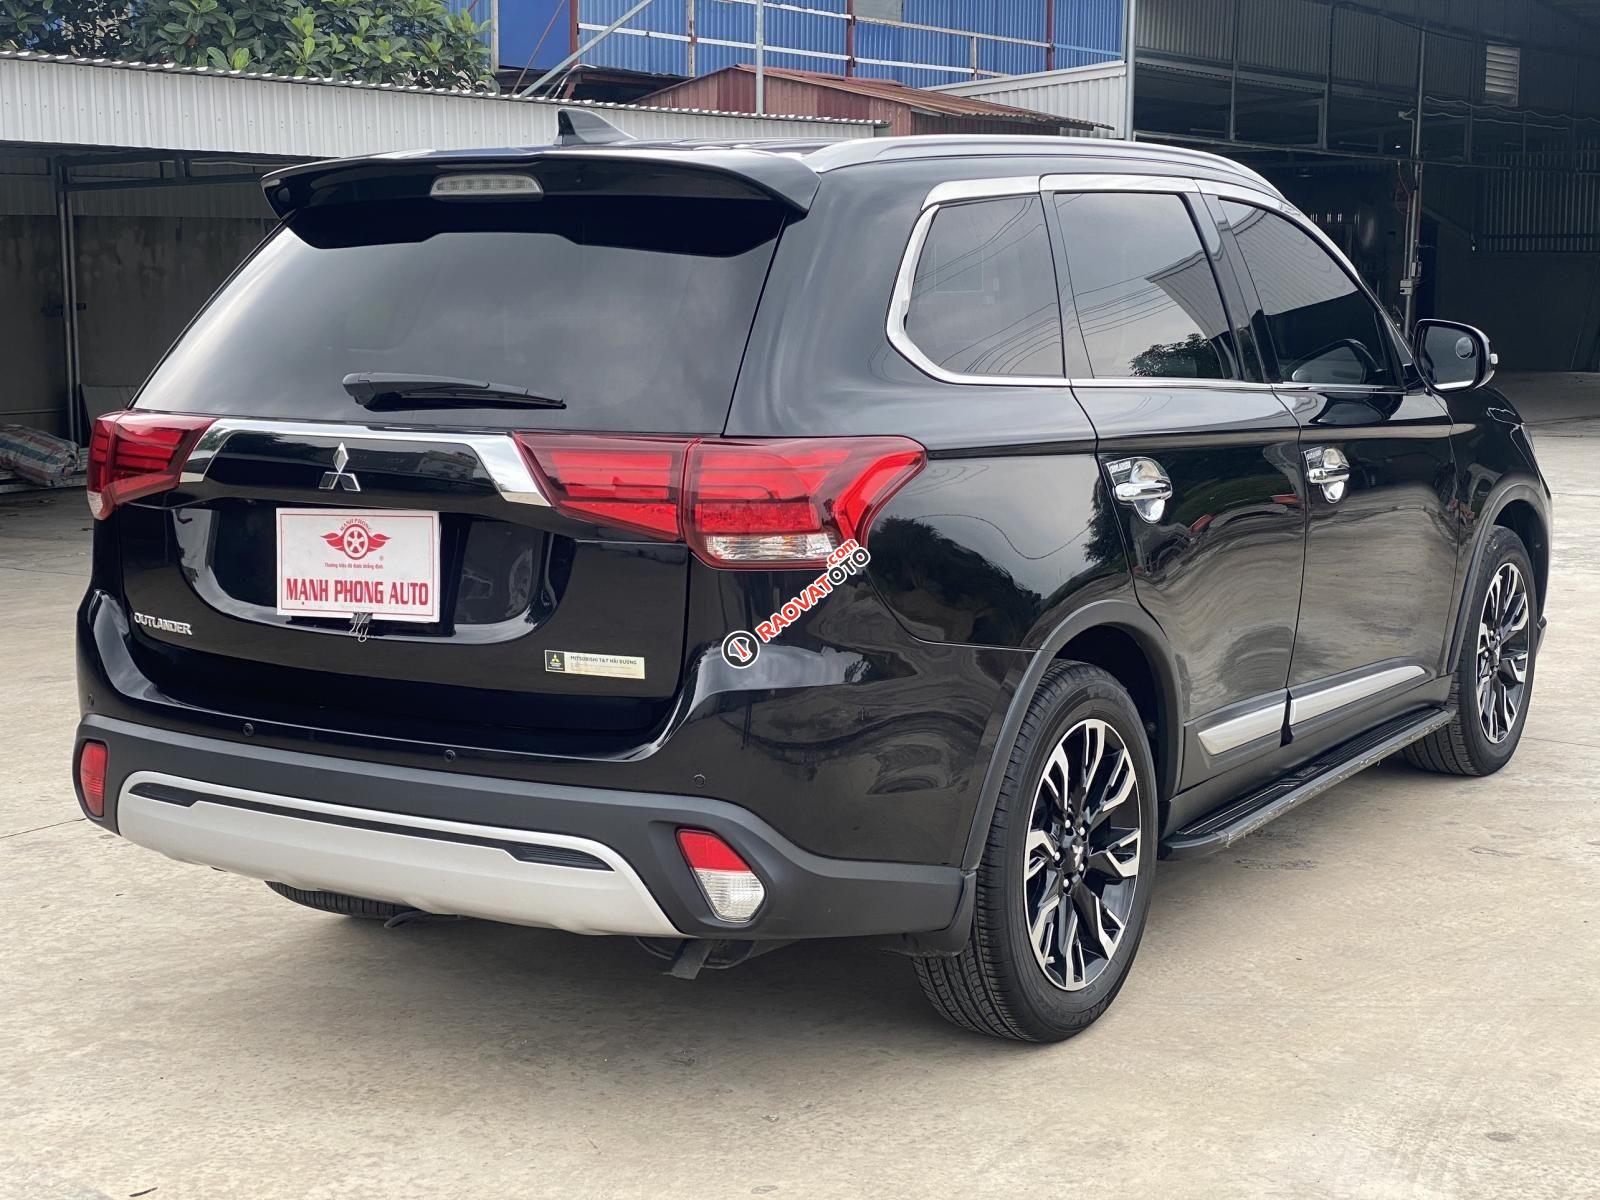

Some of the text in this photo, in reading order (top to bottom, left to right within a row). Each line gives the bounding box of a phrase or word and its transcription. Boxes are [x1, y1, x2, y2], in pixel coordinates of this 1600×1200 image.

[286, 578, 429, 606] MẠNH PHONG AUTO
[134, 612, 193, 636] OUTLANDER
